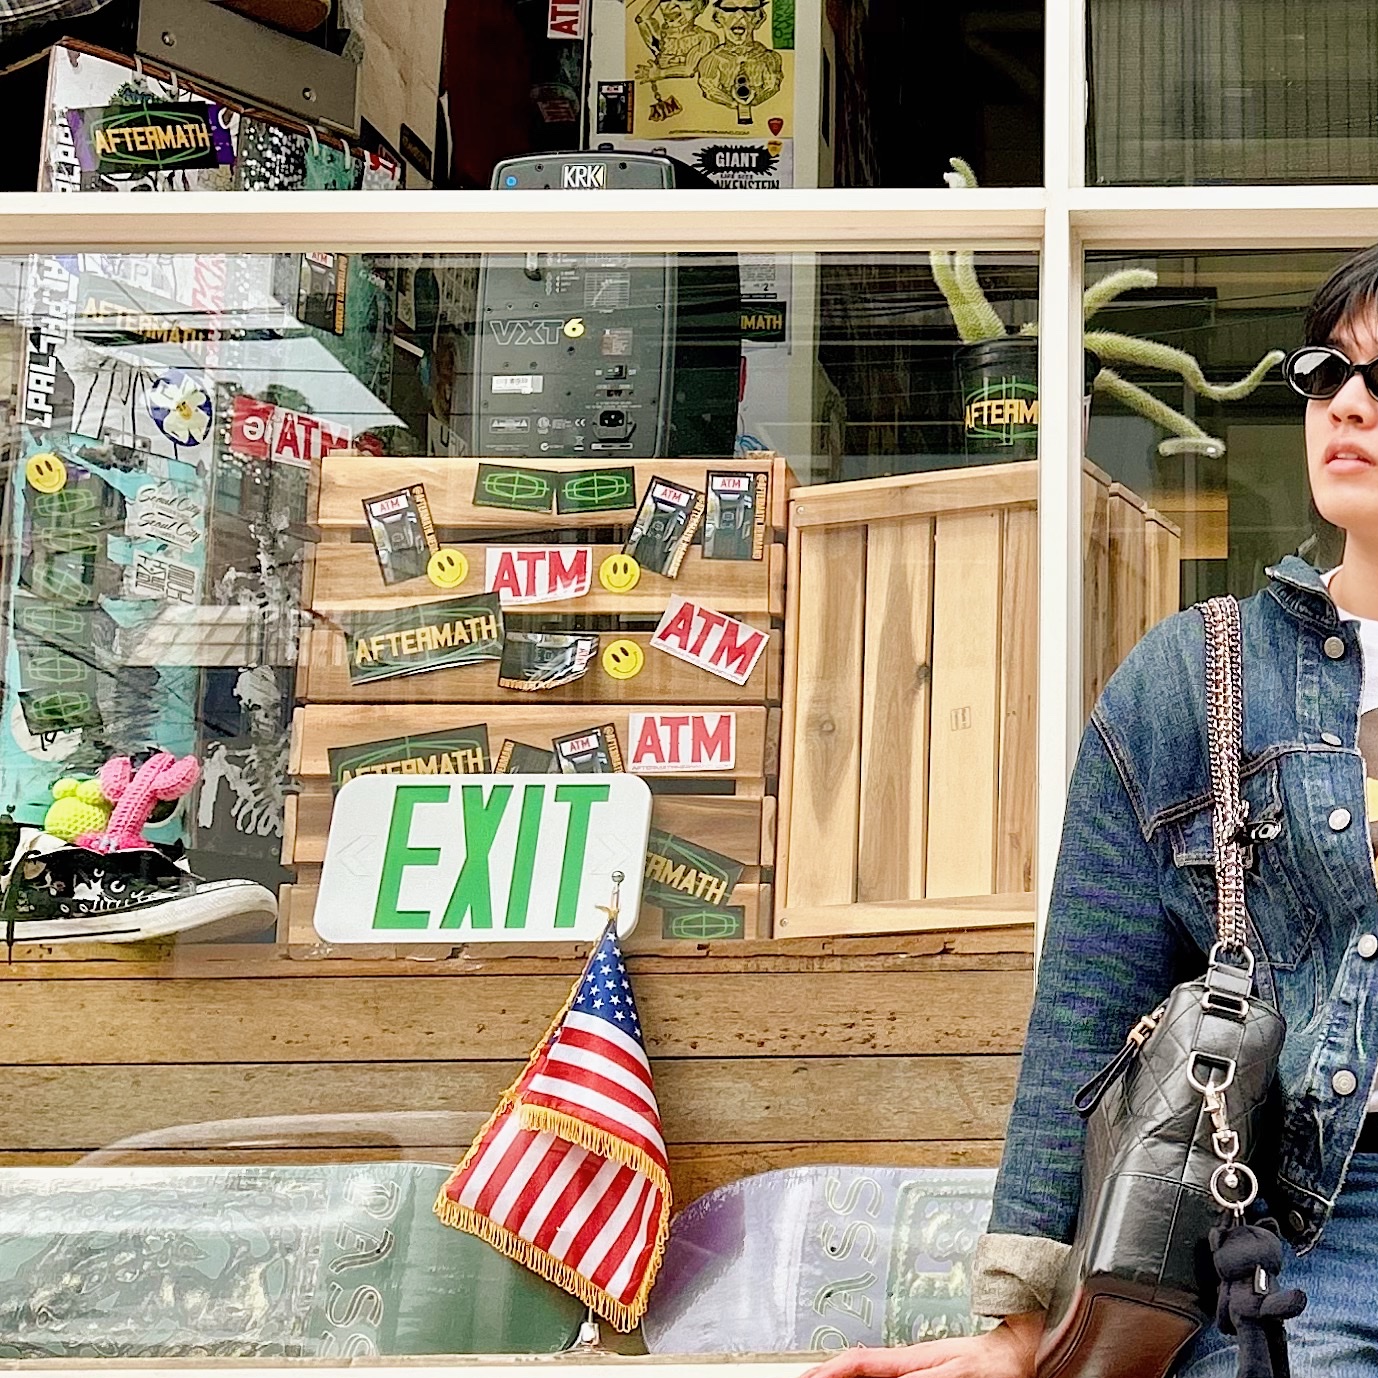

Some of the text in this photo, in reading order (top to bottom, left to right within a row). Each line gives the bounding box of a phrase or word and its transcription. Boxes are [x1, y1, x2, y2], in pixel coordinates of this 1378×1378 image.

[550, 0, 581, 36] AT
[95, 123, 210, 154] AFTERMATH
[715, 152, 760, 168] GIANT
[563, 165, 601, 189] KRK
[489, 317, 585, 346] VXT6
[660, 488, 683, 503] ATM
[720, 478, 741, 489] ATM
[380, 497, 400, 512] ATM
[137, 512, 178, 530] Seoul
[175, 521, 200, 543] City
[491, 549, 588, 597] ATM
[354, 614, 498, 664] AFTERMATH
[657, 602, 765, 676] ATM
[570, 738, 591, 753] ATM
[633, 714, 732, 764] ATM
[371, 784, 611, 930] EXIT
